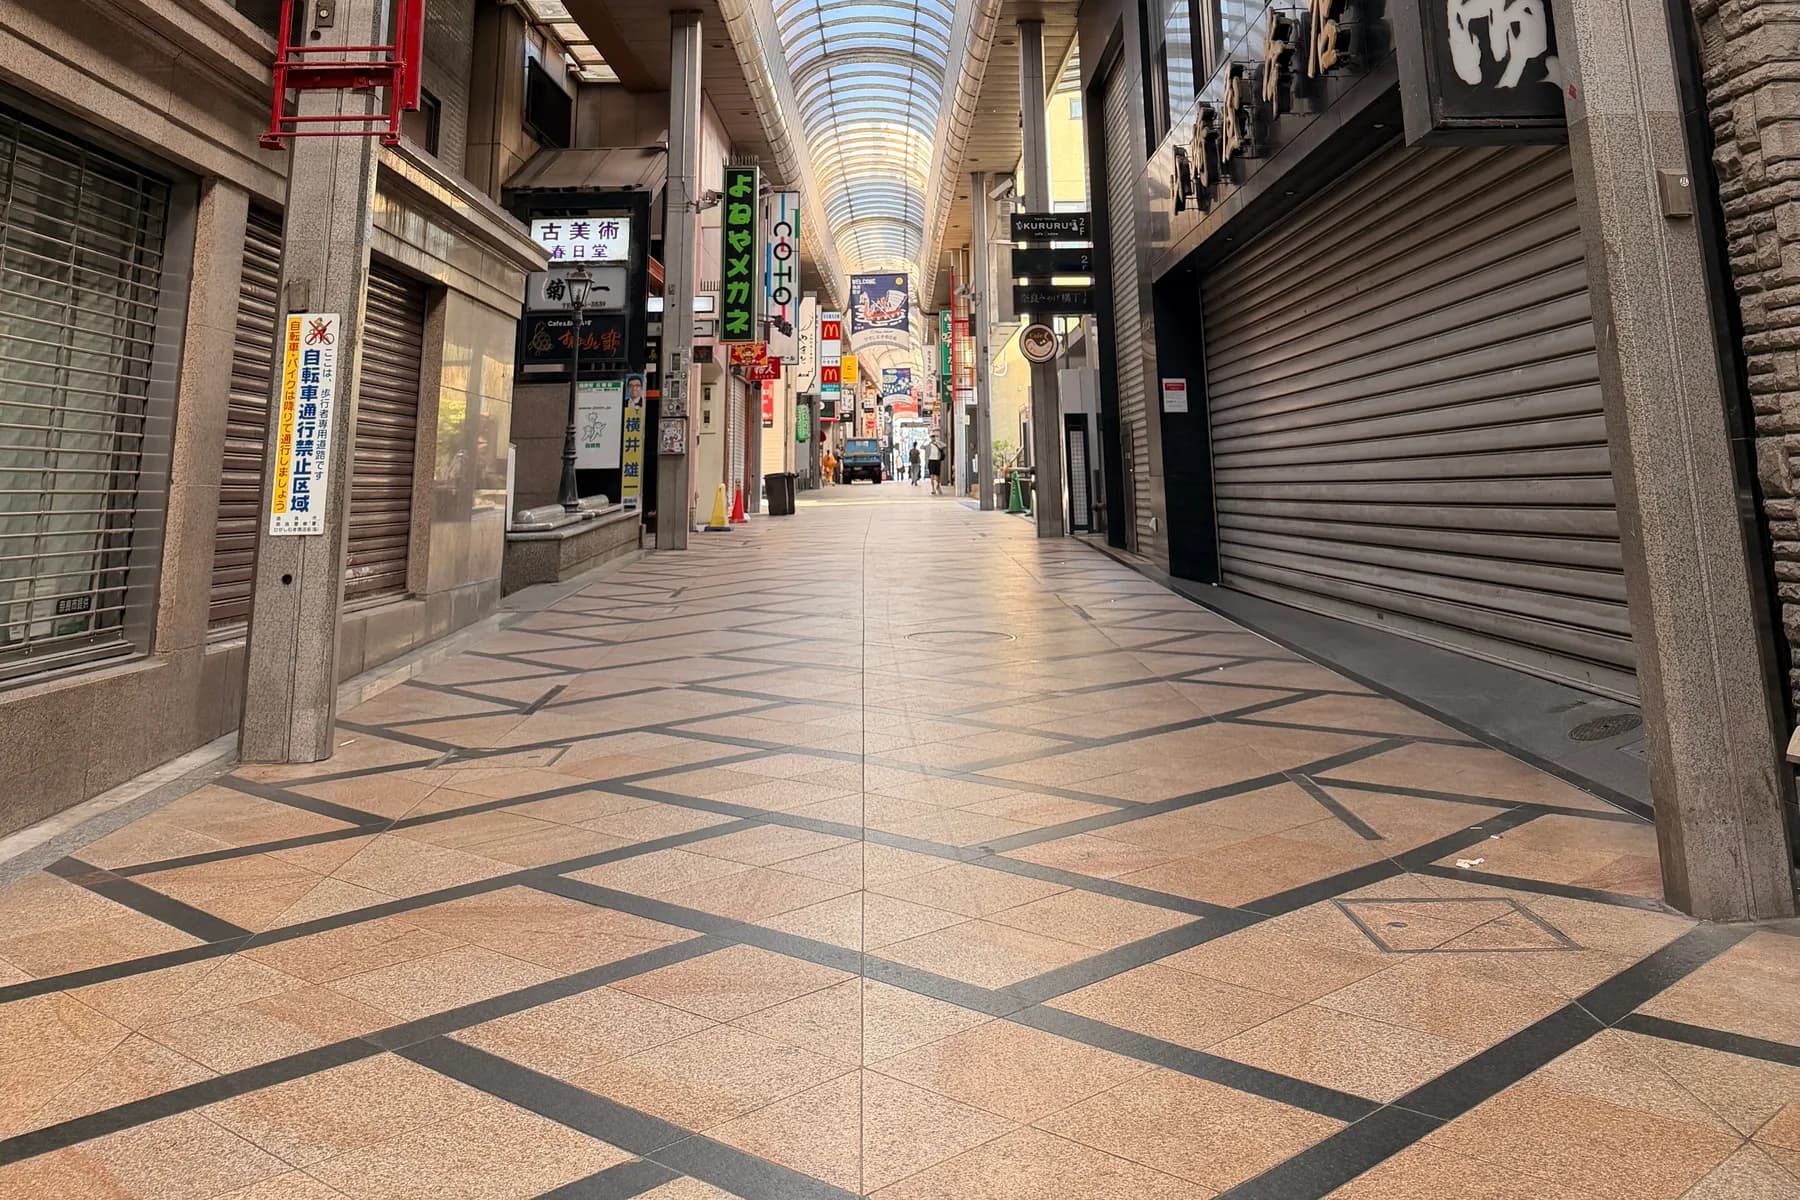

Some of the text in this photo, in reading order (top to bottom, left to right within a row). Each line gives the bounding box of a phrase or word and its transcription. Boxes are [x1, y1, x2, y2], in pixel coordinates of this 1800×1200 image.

[541, 222, 620, 241] 古美術
[551, 244, 608, 259] 春日堂
[726, 174, 752, 334] よねやメガネ
[773, 221, 792, 306] COTO
[1023, 222, 1069, 230] KURURU
[275, 320, 302, 511] 自転車・バイクは降りて通行しましょう
[290, 349, 320, 513] 自転車通行禁止区域
[315, 348, 333, 481] ここは、歩行者専用道路です
[624, 417, 641, 488] 横井雄一
